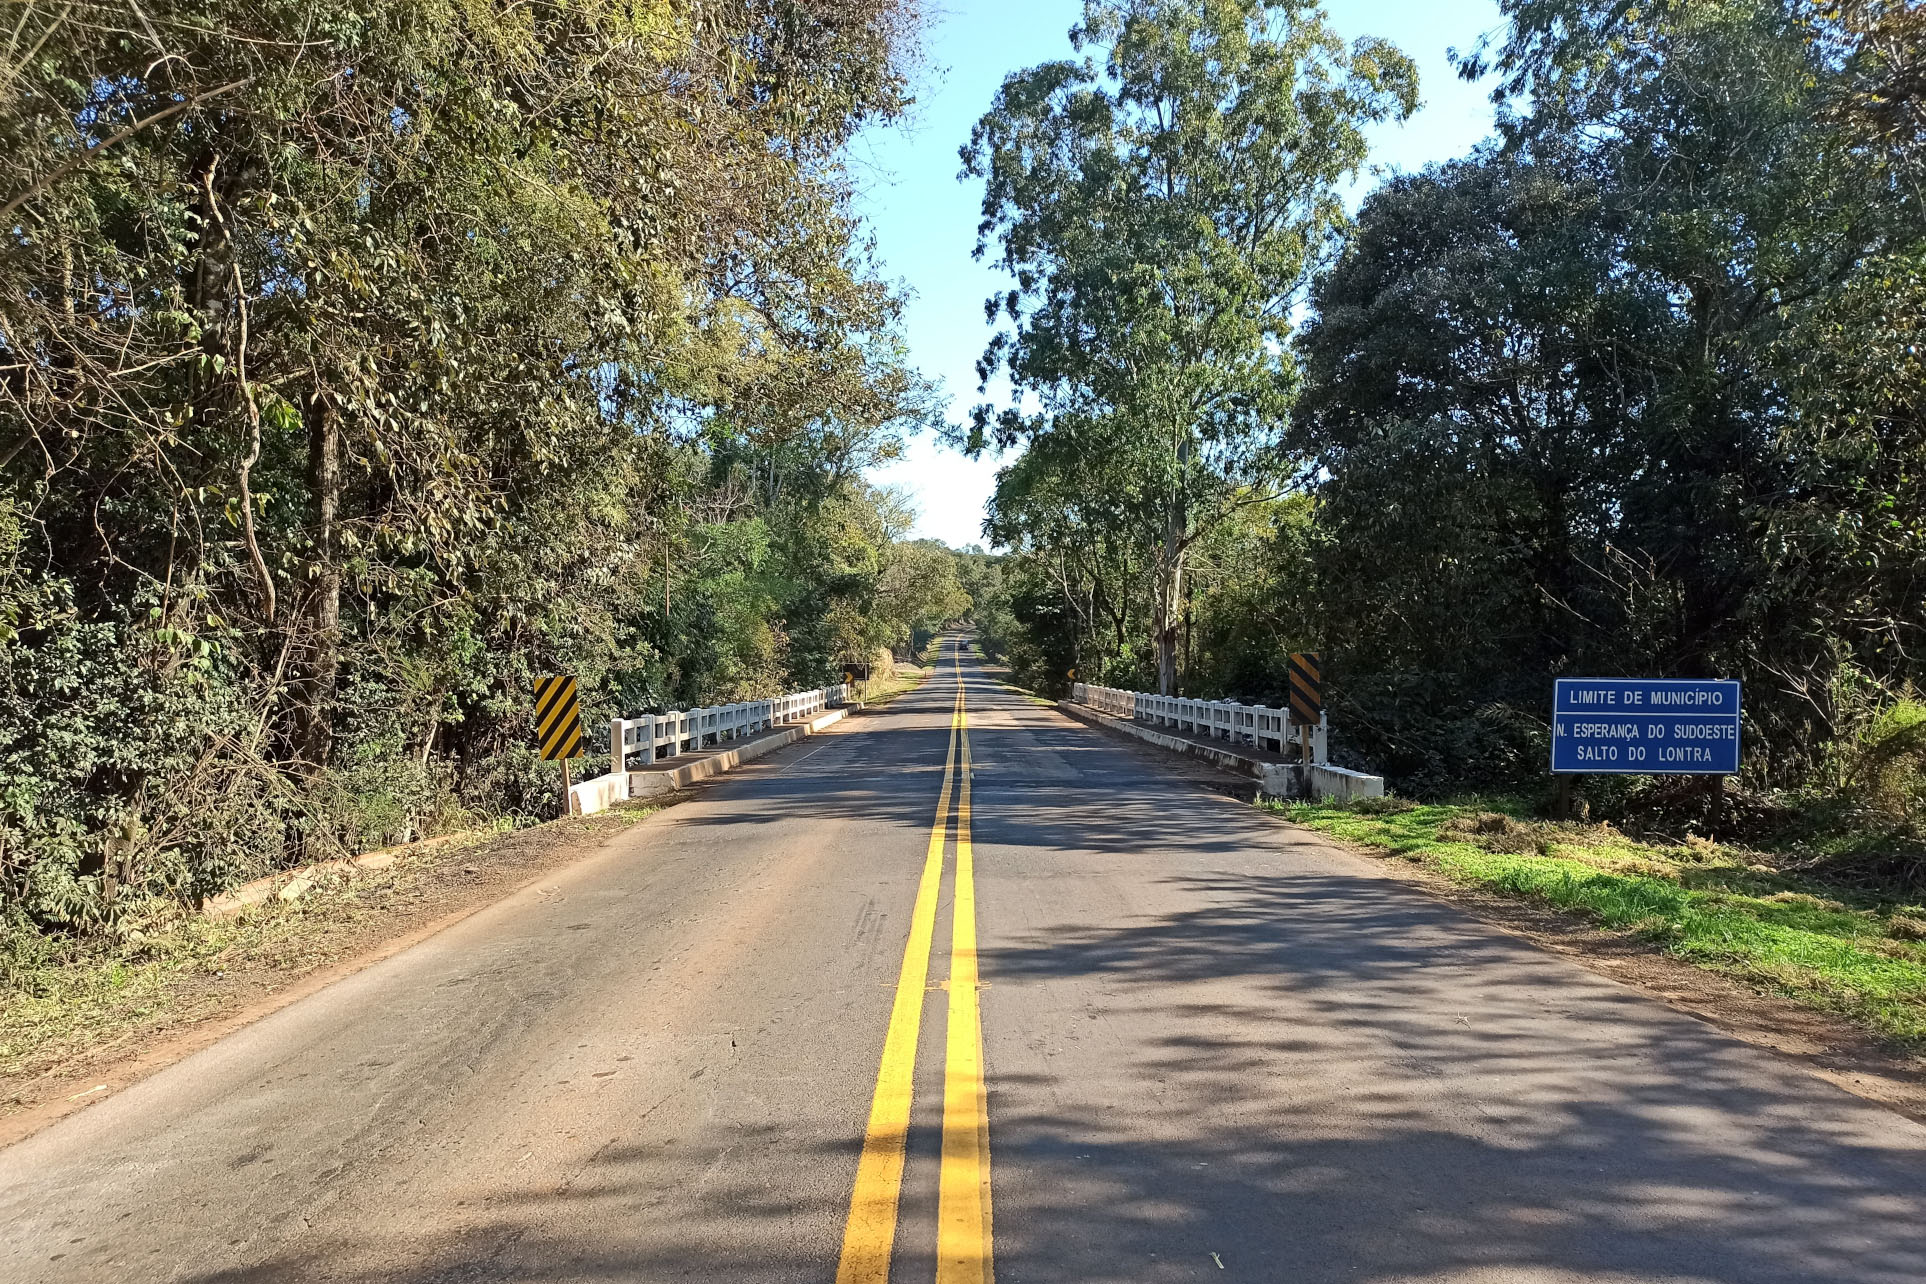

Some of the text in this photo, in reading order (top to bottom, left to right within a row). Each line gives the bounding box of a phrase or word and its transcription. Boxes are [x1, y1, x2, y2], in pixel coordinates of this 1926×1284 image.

[1569, 687, 1723, 706] LIMITE DE MUNICÍPIO
[1556, 723, 1735, 742] N. ESPERANÇA DO SUDOESTE
[1577, 745, 1712, 762] SALTO DO LONTRA
